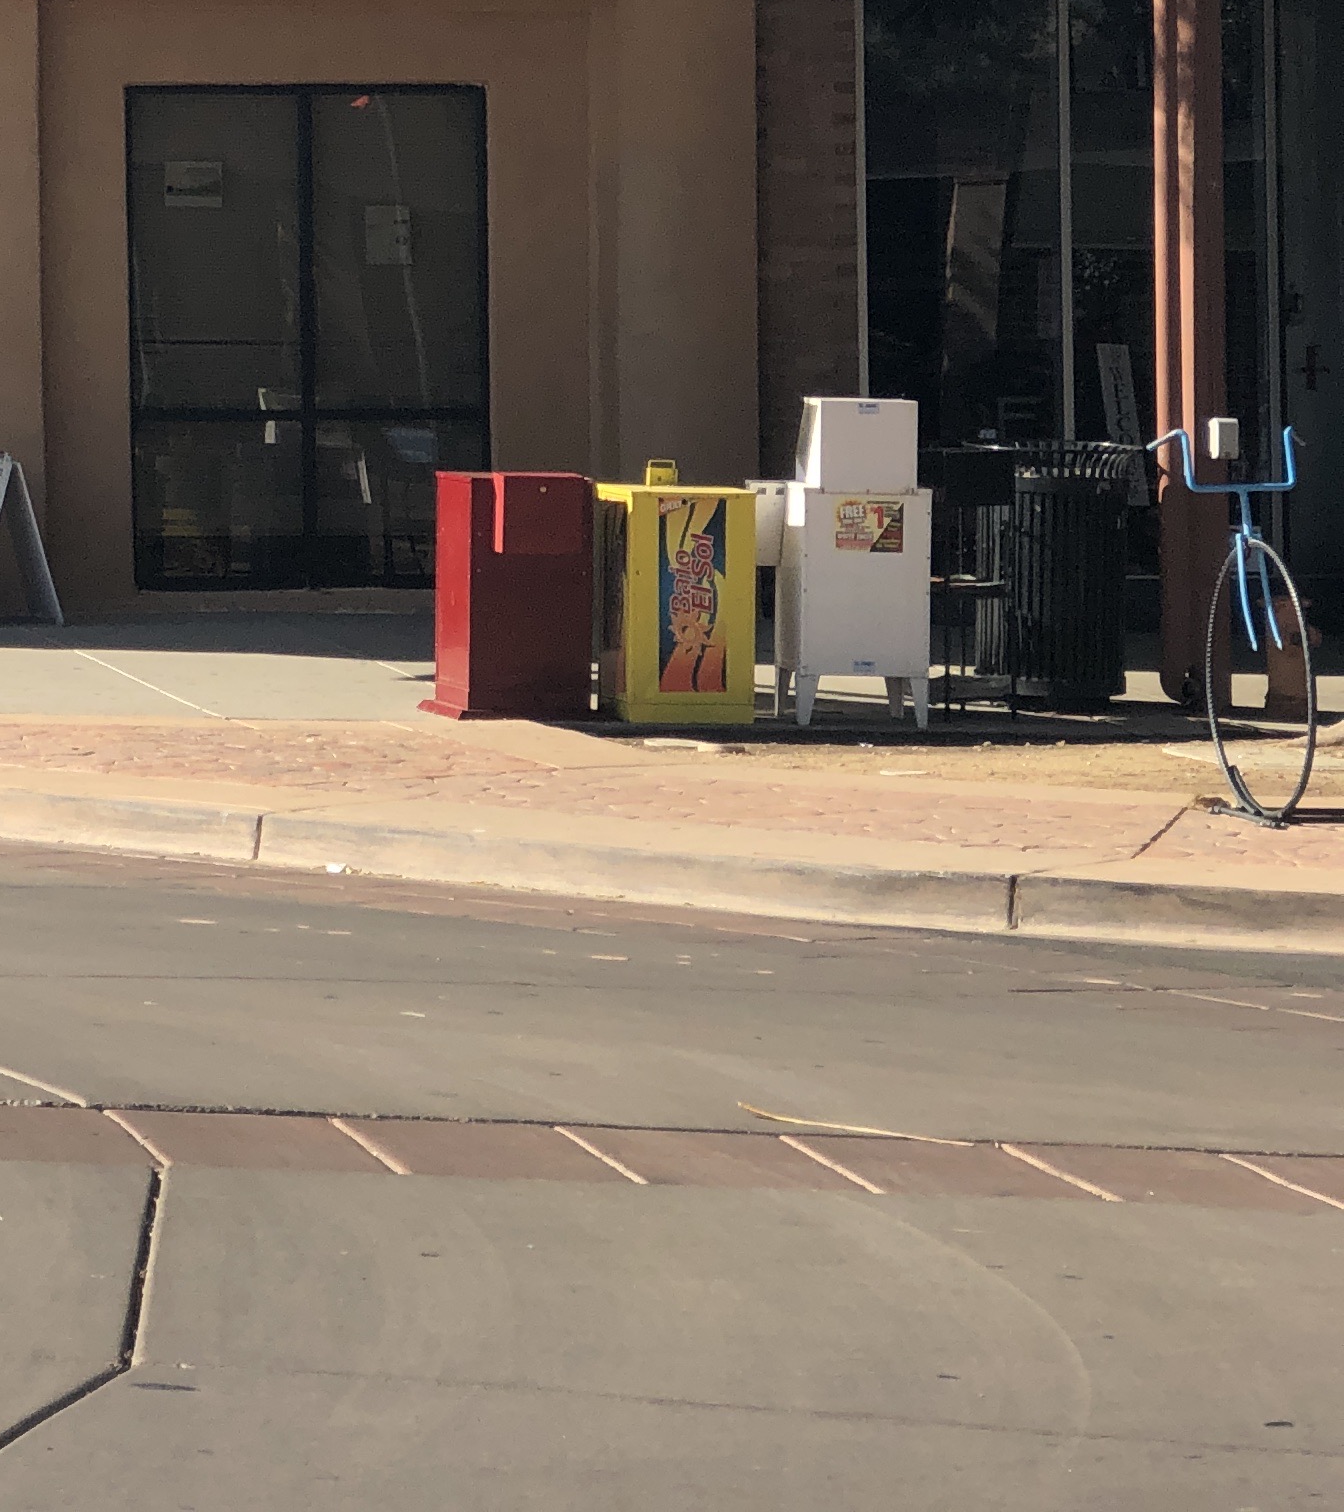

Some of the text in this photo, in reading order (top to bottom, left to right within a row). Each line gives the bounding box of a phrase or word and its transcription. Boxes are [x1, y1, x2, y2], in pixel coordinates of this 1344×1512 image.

[840, 504, 865, 519] FREE
[669, 549, 691, 615] Bajo
[690, 532, 714, 613] El Sol
